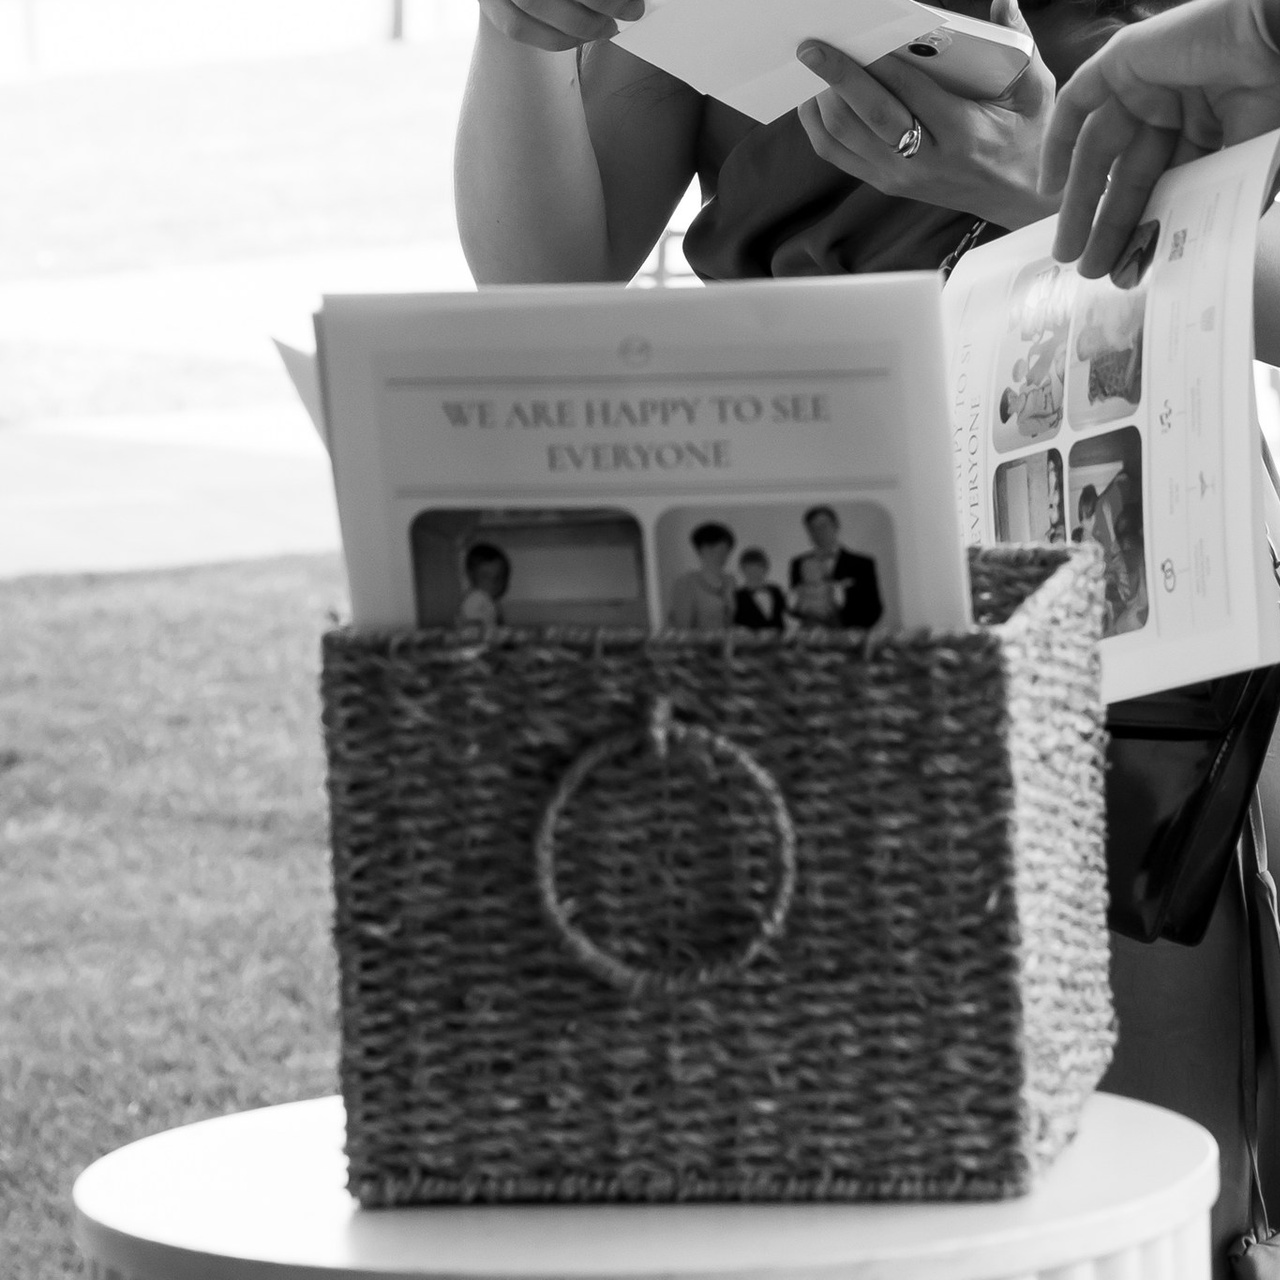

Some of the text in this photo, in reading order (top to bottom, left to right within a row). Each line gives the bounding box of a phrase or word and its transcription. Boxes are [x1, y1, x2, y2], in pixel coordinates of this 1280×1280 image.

[442, 393, 832, 428] WE ARE HAPPY TO SEE
[547, 439, 731, 471] EVERYONE
[968, 395, 981, 544] EVERYONE
